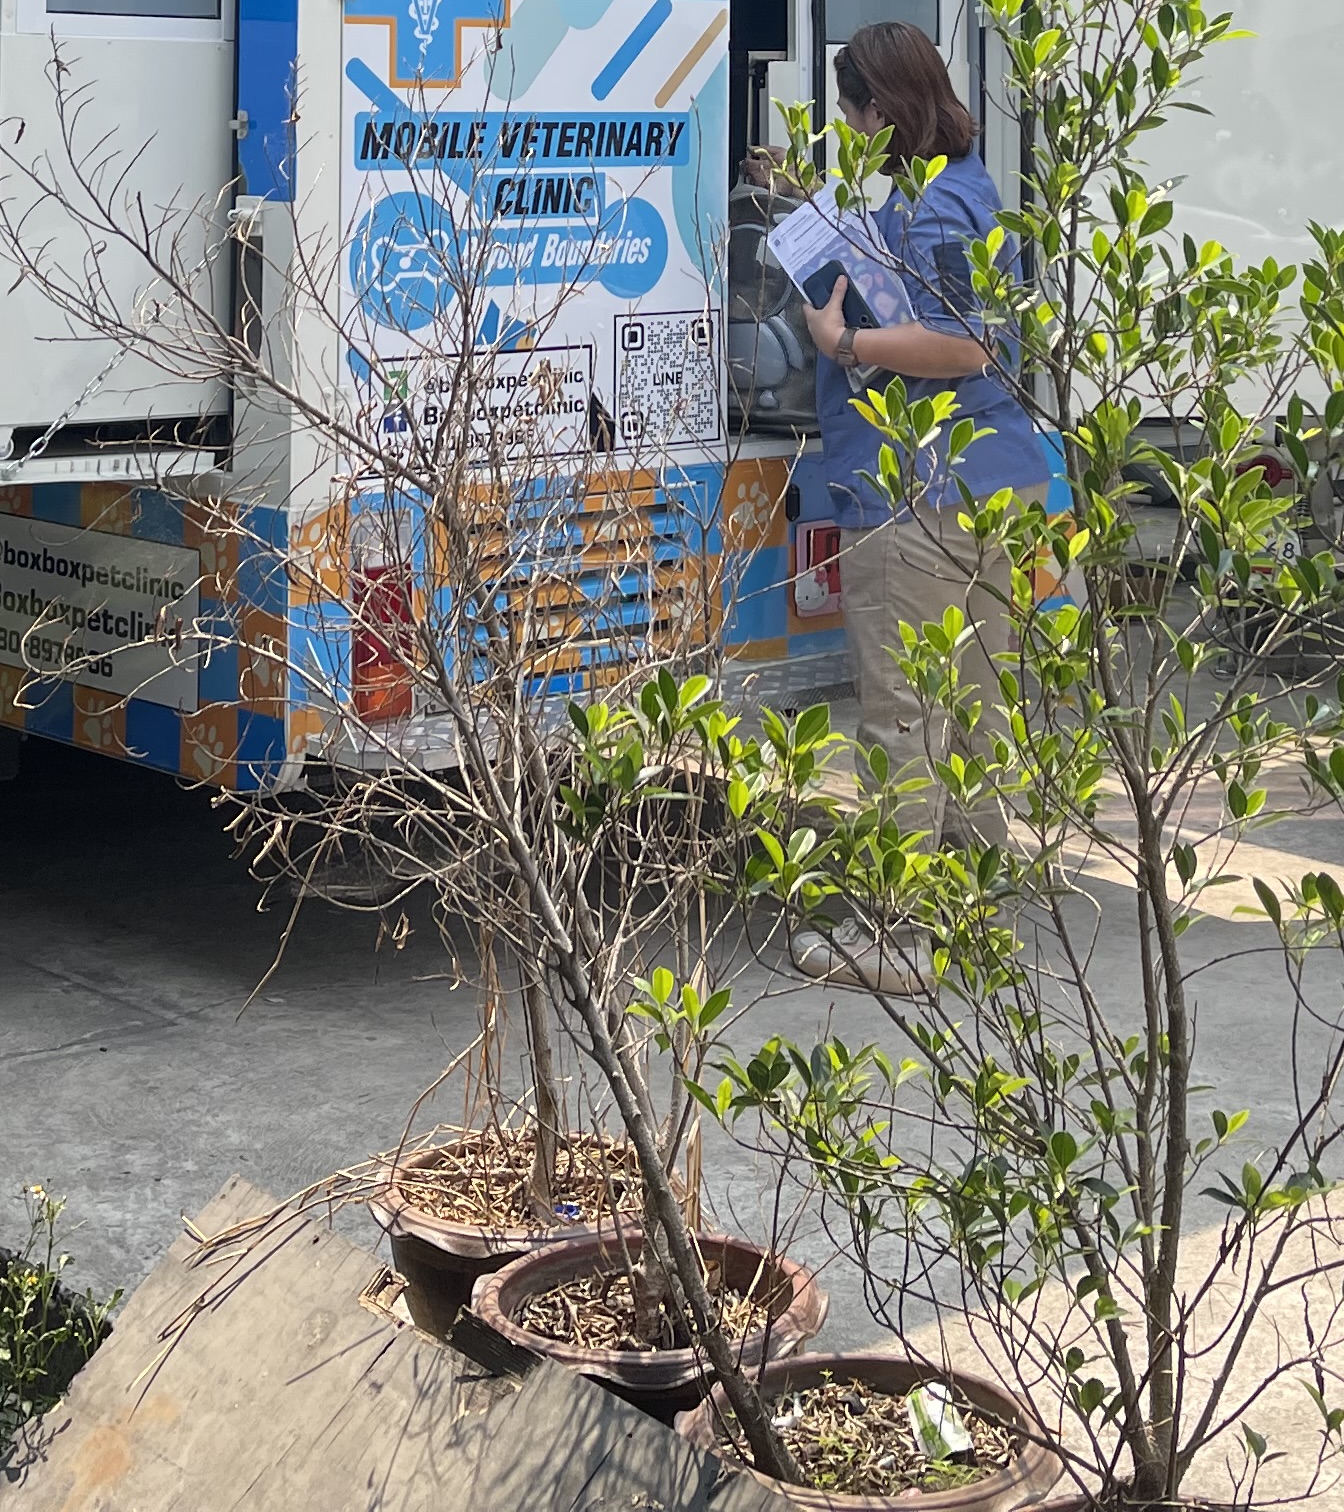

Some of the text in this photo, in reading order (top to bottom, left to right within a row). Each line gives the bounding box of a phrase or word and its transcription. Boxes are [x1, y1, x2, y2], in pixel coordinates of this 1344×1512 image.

[360, 121, 687, 160] MOBILE VETERINARY
[492, 175, 595, 216] CLINIC
[653, 371, 683, 386] LINE
